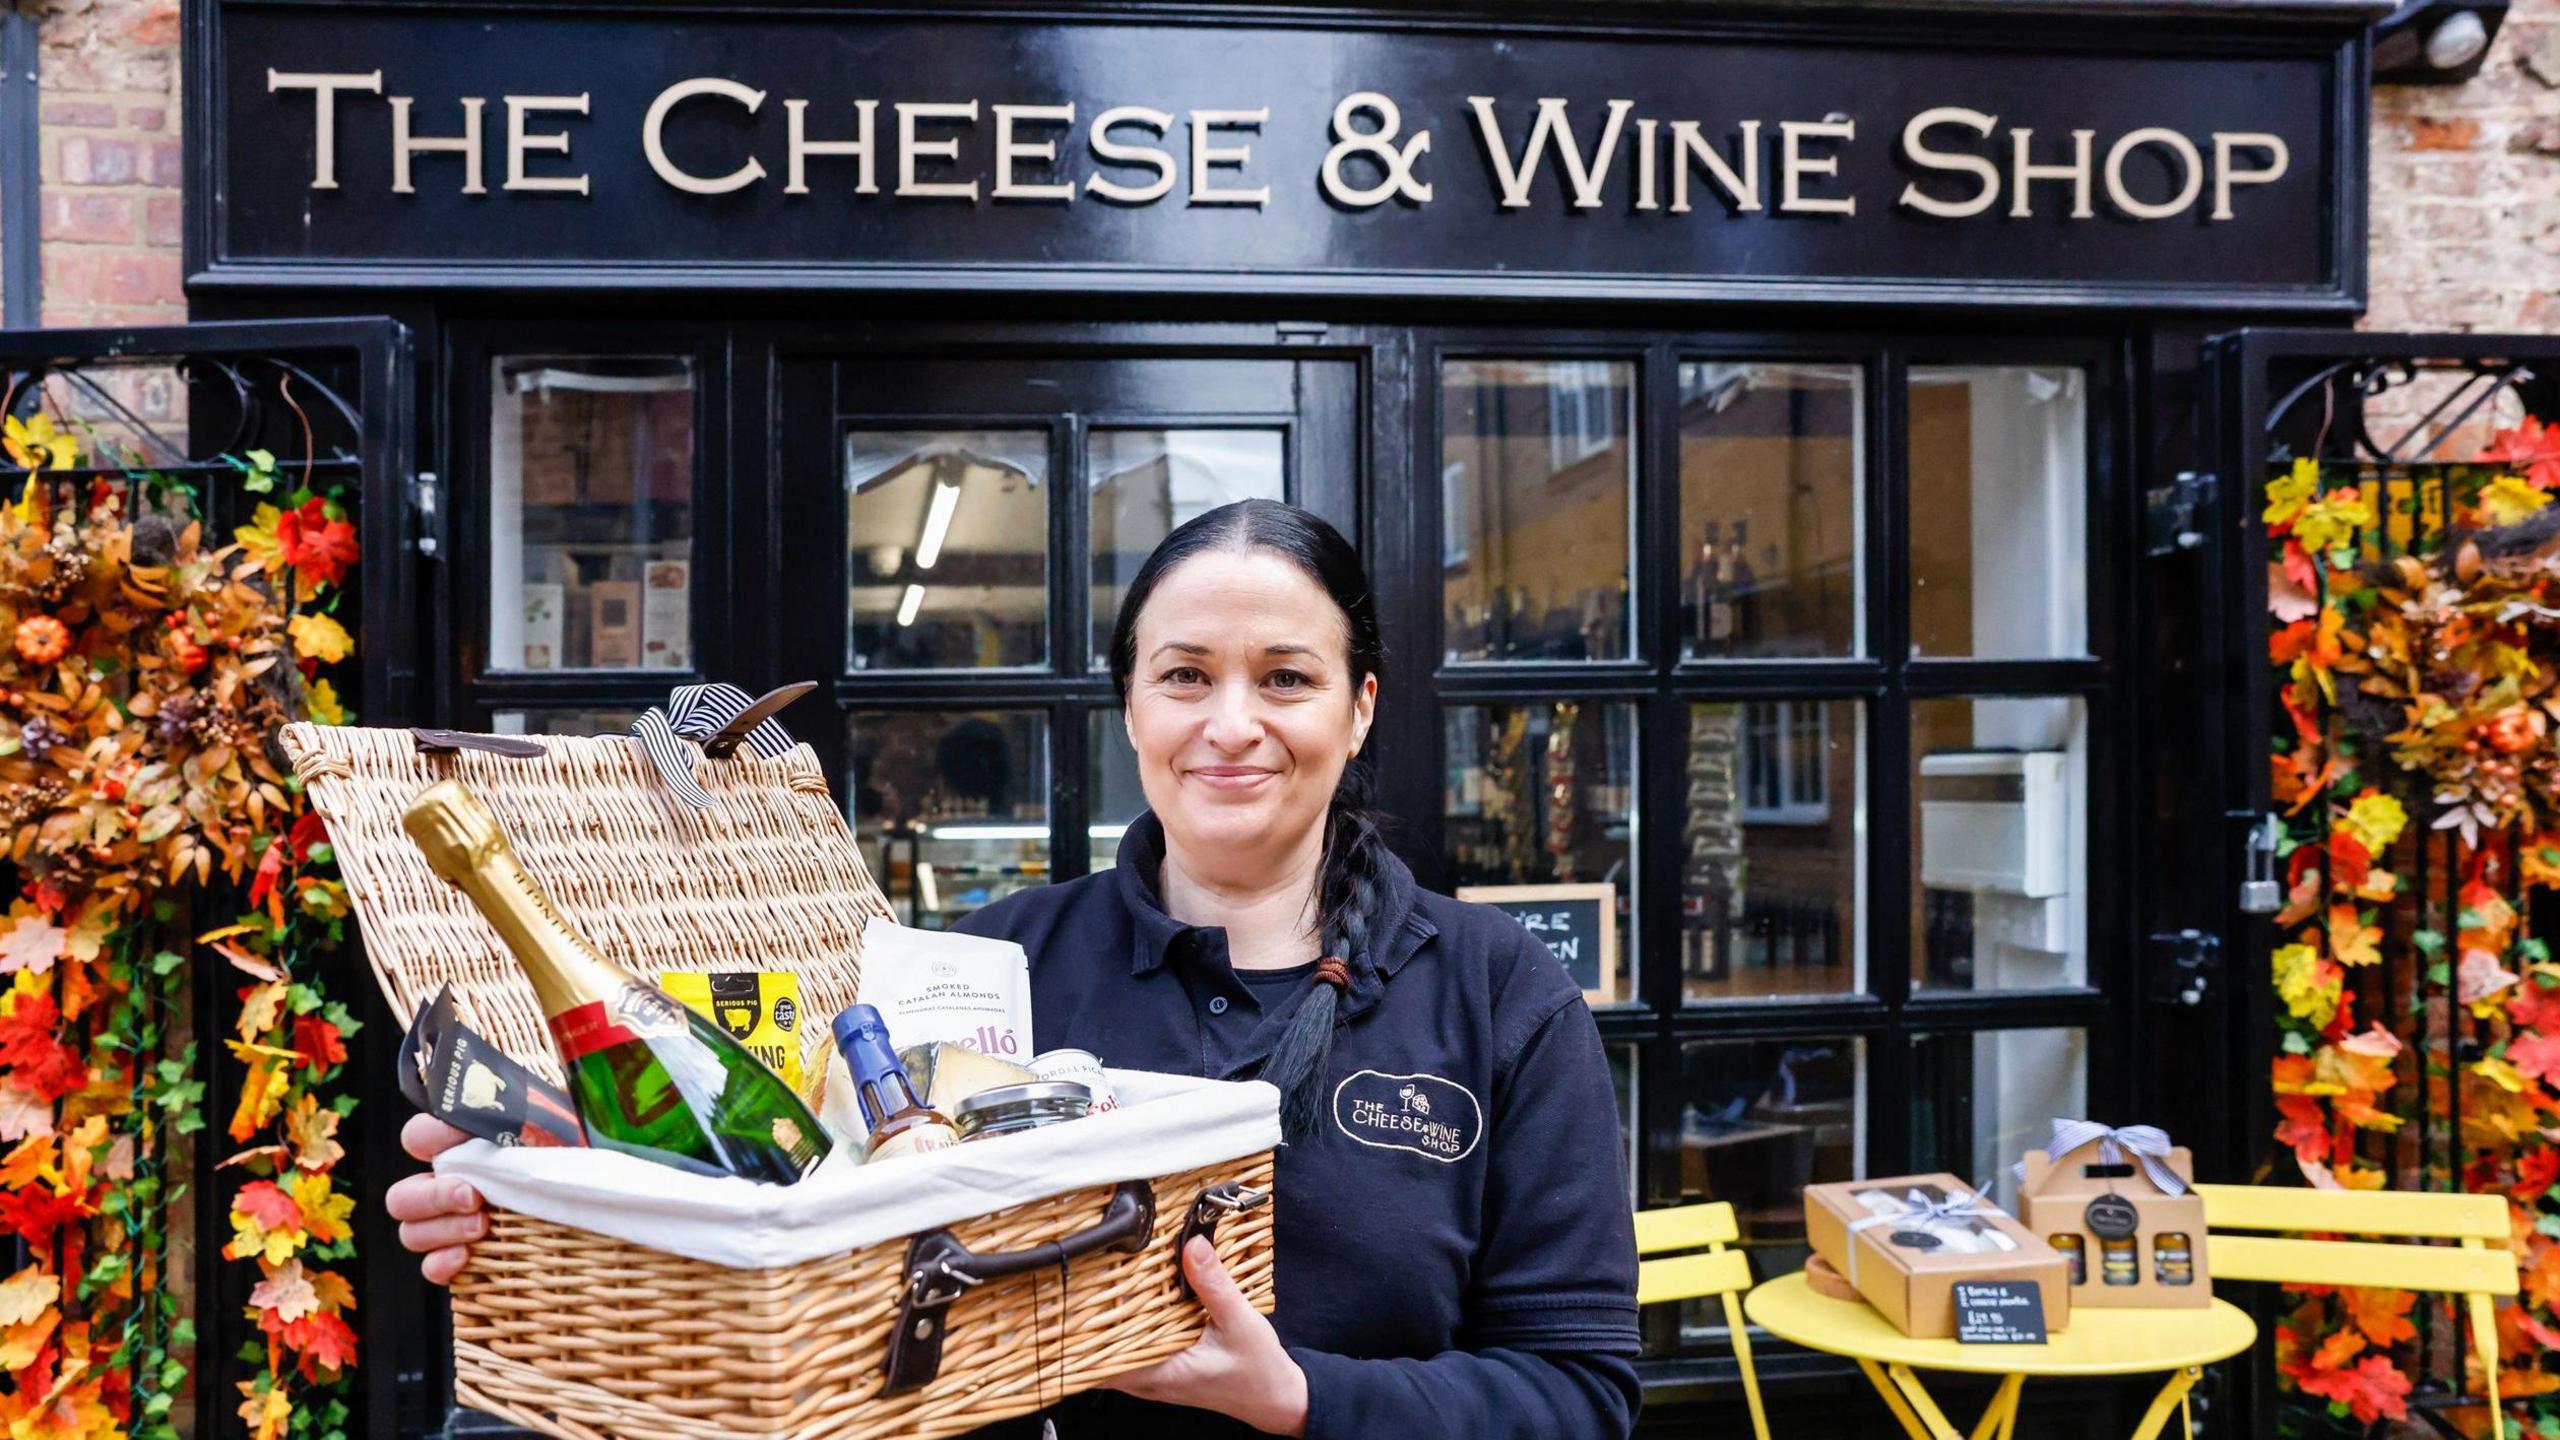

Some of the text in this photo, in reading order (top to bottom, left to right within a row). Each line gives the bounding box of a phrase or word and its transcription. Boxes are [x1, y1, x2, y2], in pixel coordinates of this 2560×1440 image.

[267, 68, 2289, 219] THE CHEESE & WINE SHOP
[926, 983, 970, 992] SMOKED
[898, 991, 1001, 1006] CATALAN ALMONDS
[951, 1025, 1017, 1055] elló
[441, 1037, 469, 1112] SERIOUS PIG
[1353, 1099, 1385, 1112] THE
[1421, 1136, 1461, 1154] SHOP
